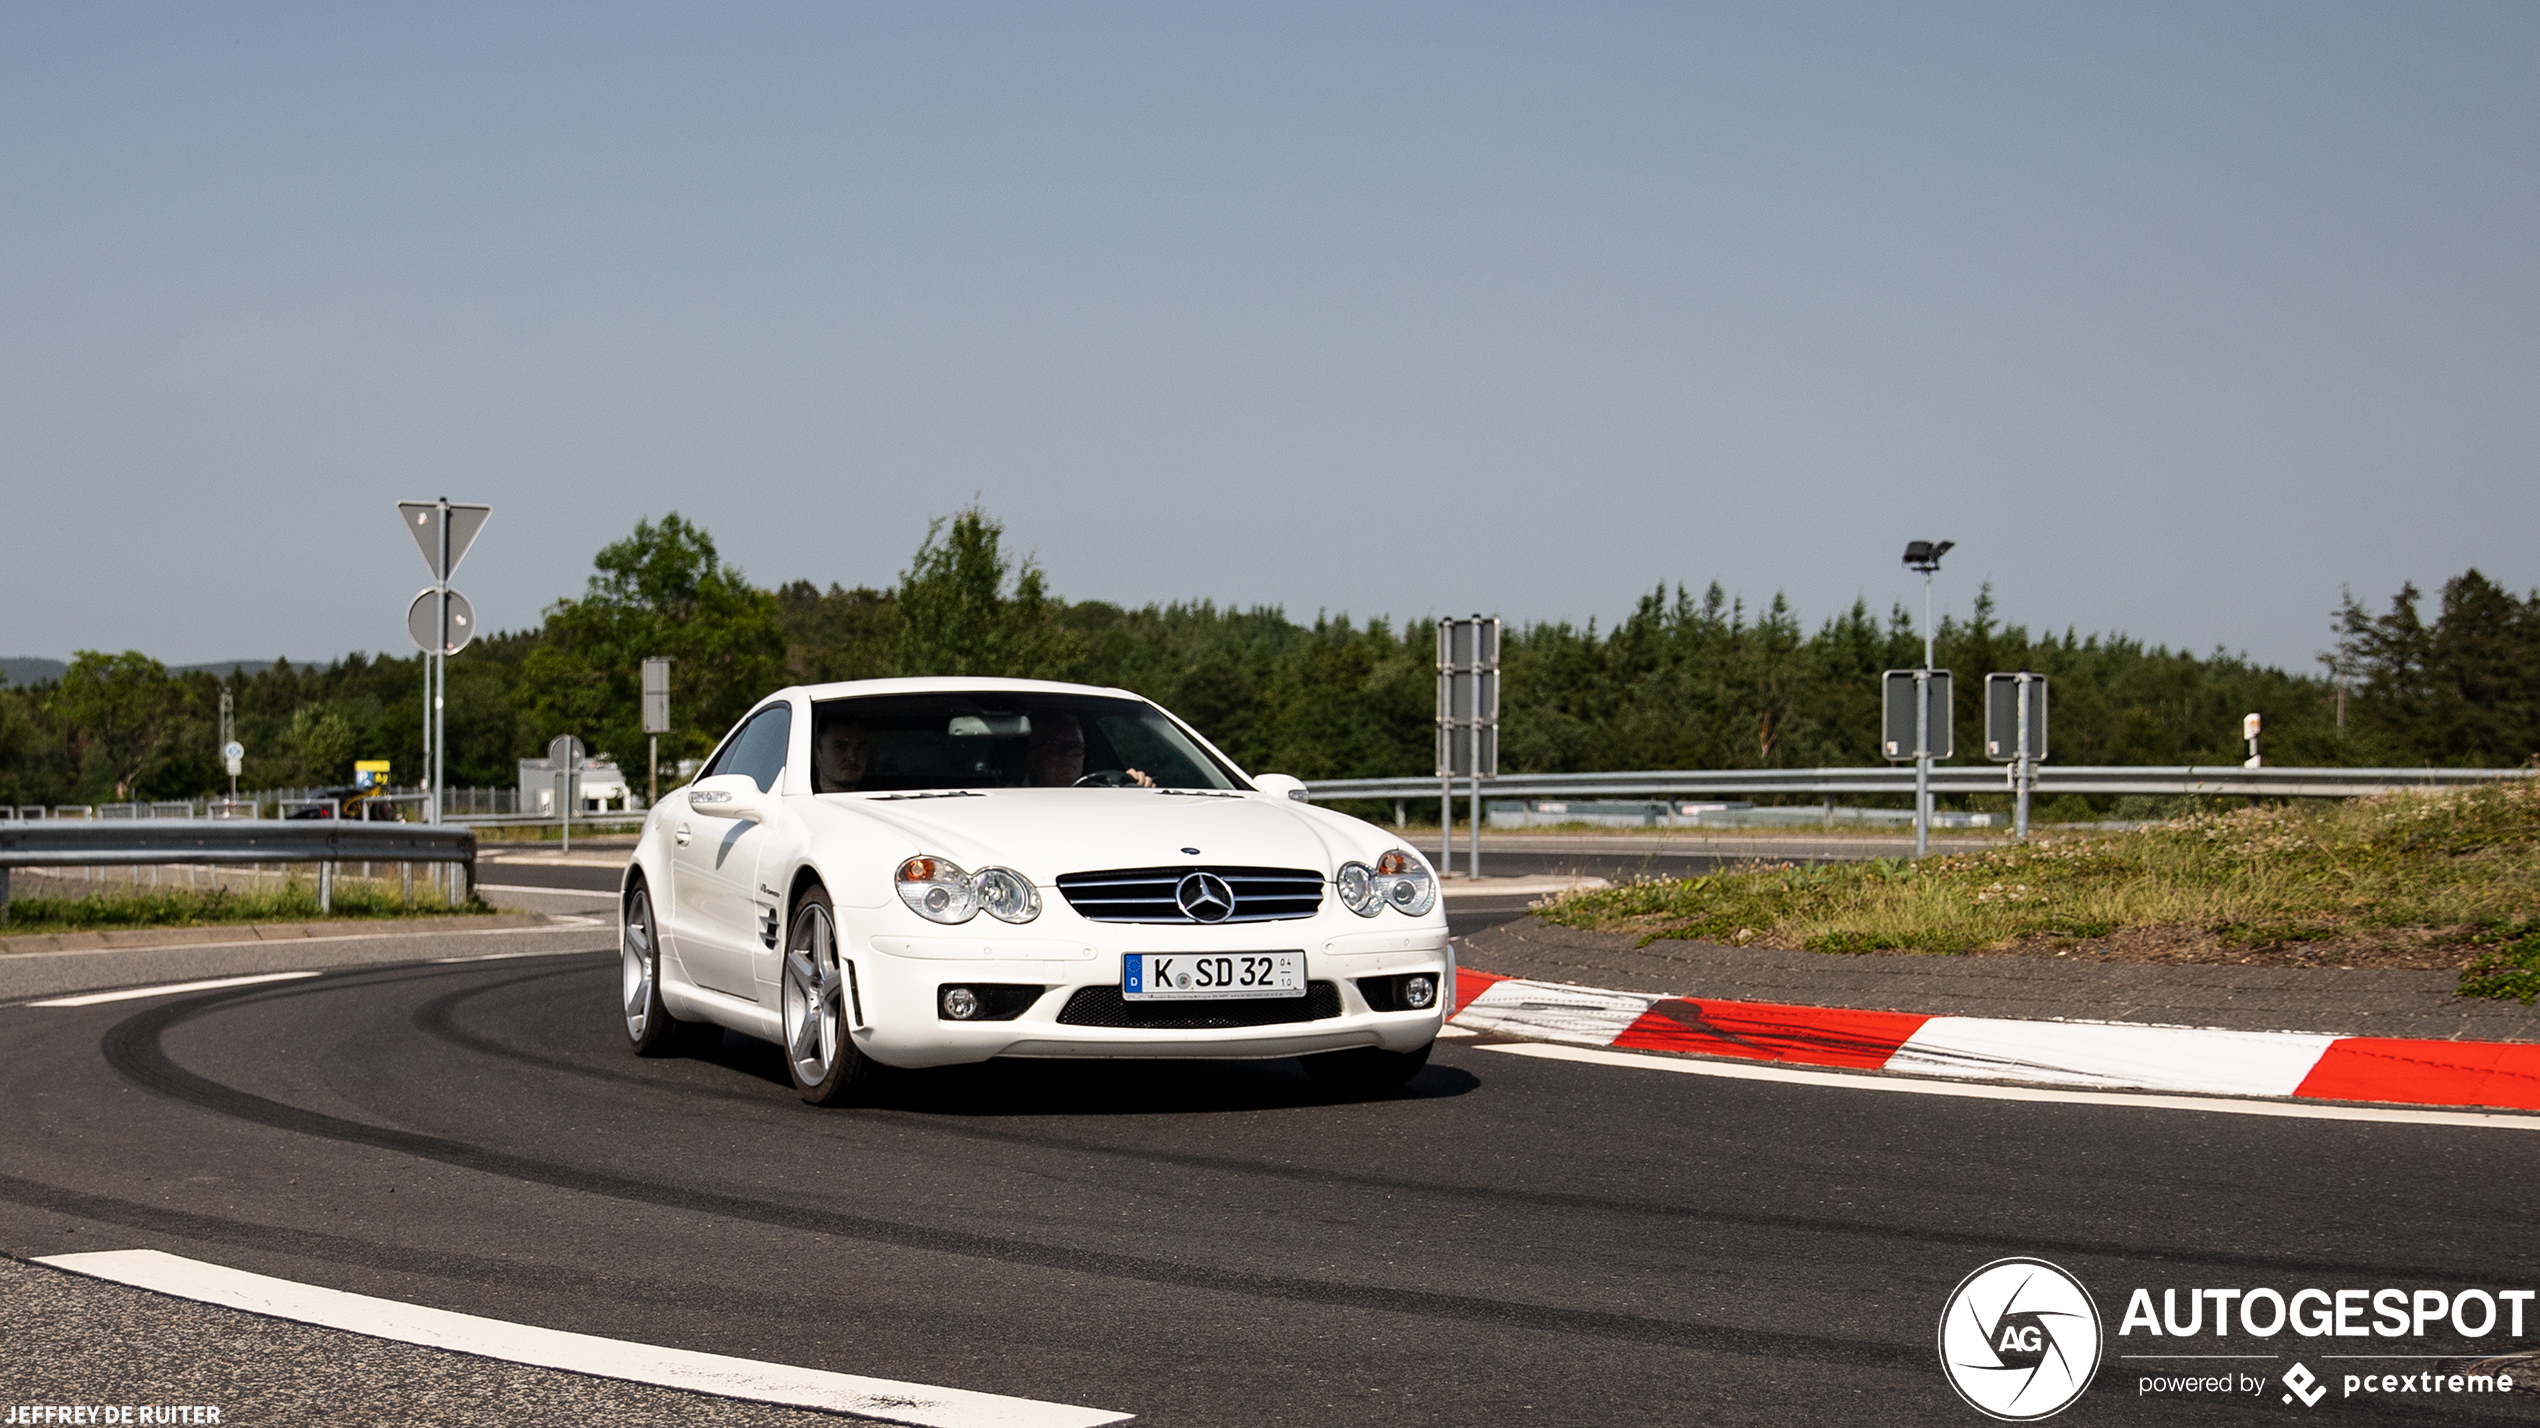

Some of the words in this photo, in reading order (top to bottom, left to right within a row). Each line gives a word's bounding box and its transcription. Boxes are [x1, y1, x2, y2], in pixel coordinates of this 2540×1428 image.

[1279, 957, 1292, 967] 04
[1154, 958, 1174, 988] K
[1195, 957, 1233, 987] SD
[1239, 957, 1274, 986] 32
[1130, 976, 1138, 987] D
[1280, 978, 1292, 987] 10
